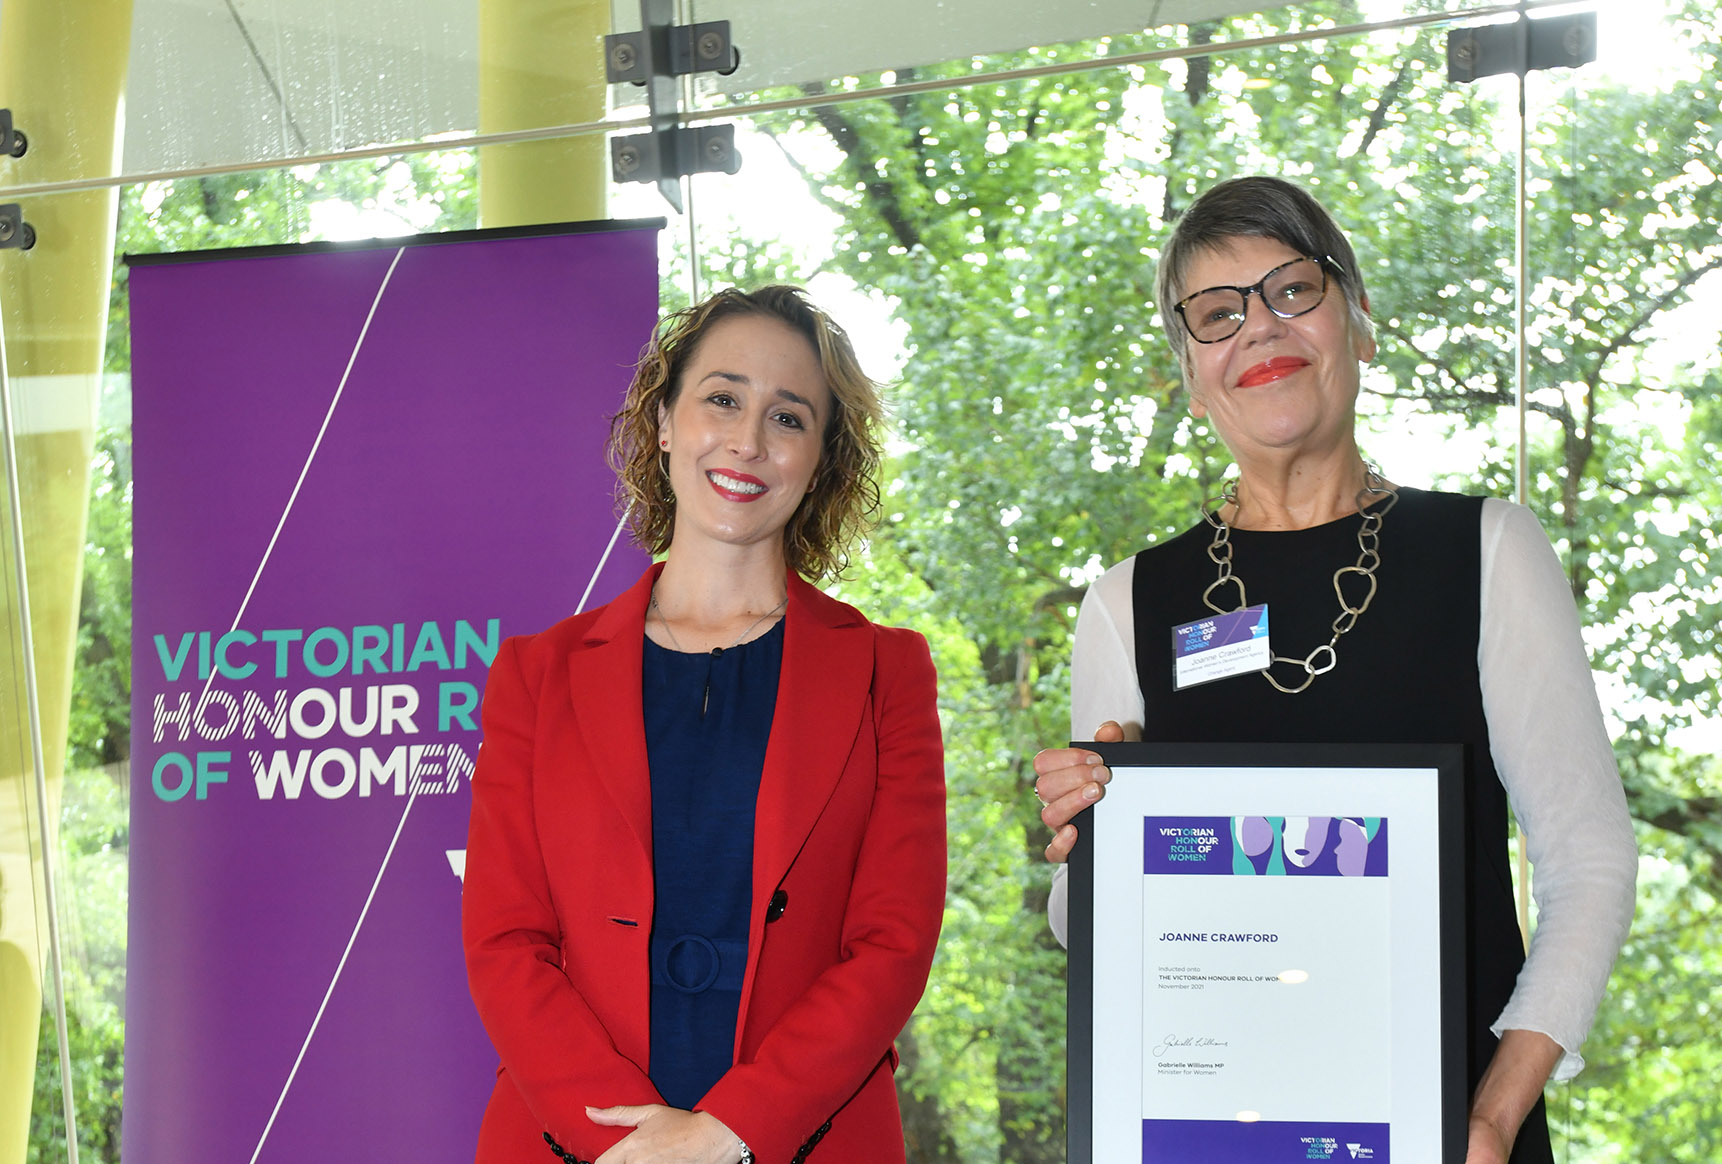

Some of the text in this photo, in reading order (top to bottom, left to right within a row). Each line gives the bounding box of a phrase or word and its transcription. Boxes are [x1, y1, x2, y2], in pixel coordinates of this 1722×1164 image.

[1202, 633, 1213, 641] OF
[153, 619, 500, 681] VICTORIAN
[153, 681, 486, 743] HONOUR R
[151, 742, 483, 802] OF WOMEN
[1159, 828, 1214, 836] VICTORIAN
[1175, 837, 1219, 845] HONOUR
[1171, 845, 1212, 853] ROLL OF
[1168, 853, 1206, 861] WOMEN
[1159, 932, 1279, 943] JOANNE CRAWFORD
